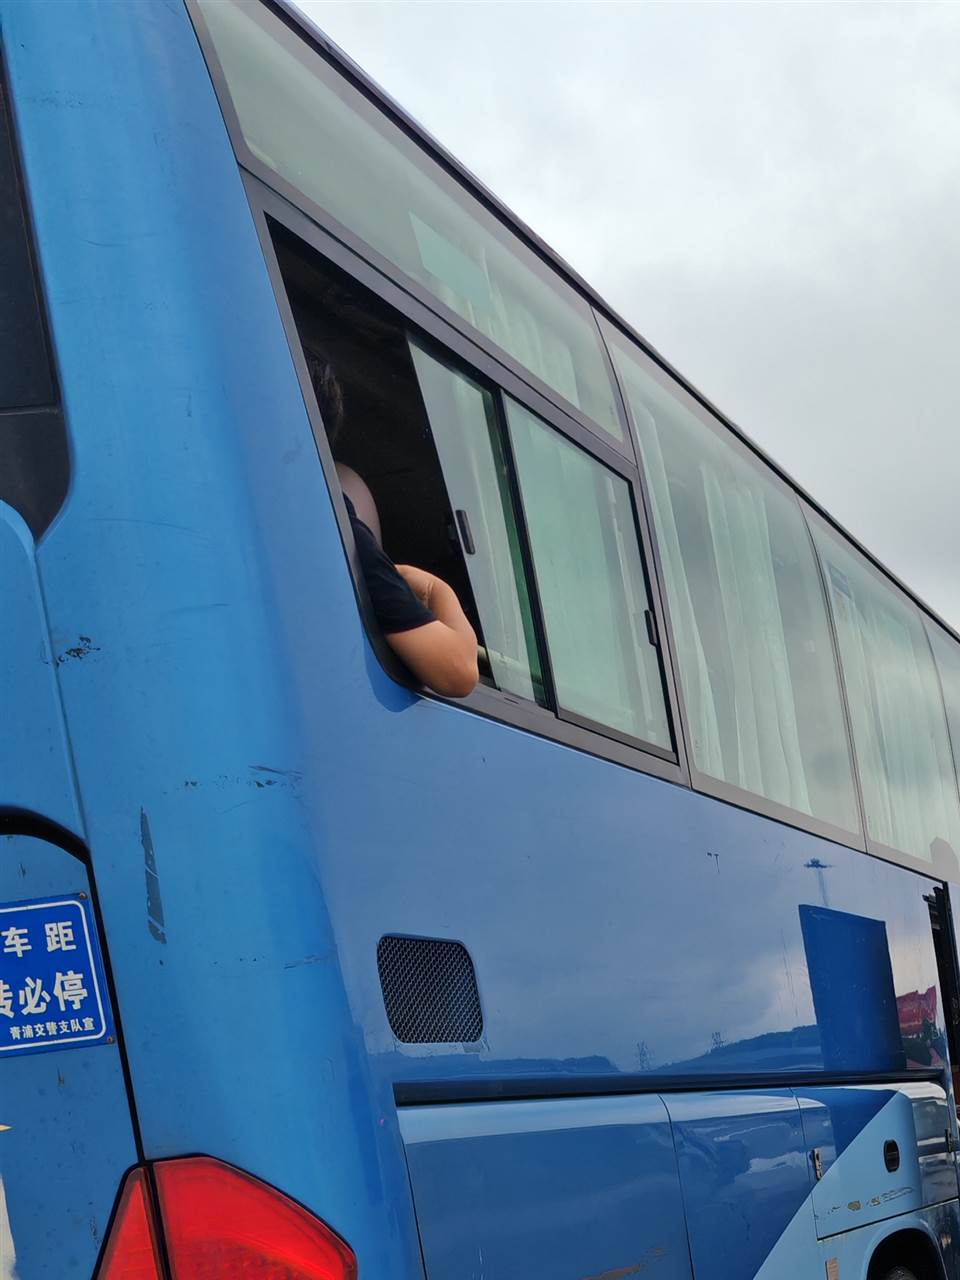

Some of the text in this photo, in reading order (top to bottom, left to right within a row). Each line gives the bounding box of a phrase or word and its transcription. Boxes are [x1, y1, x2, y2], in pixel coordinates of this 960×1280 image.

[9, 1017, 95, 1039] 青浦交警支队宣
